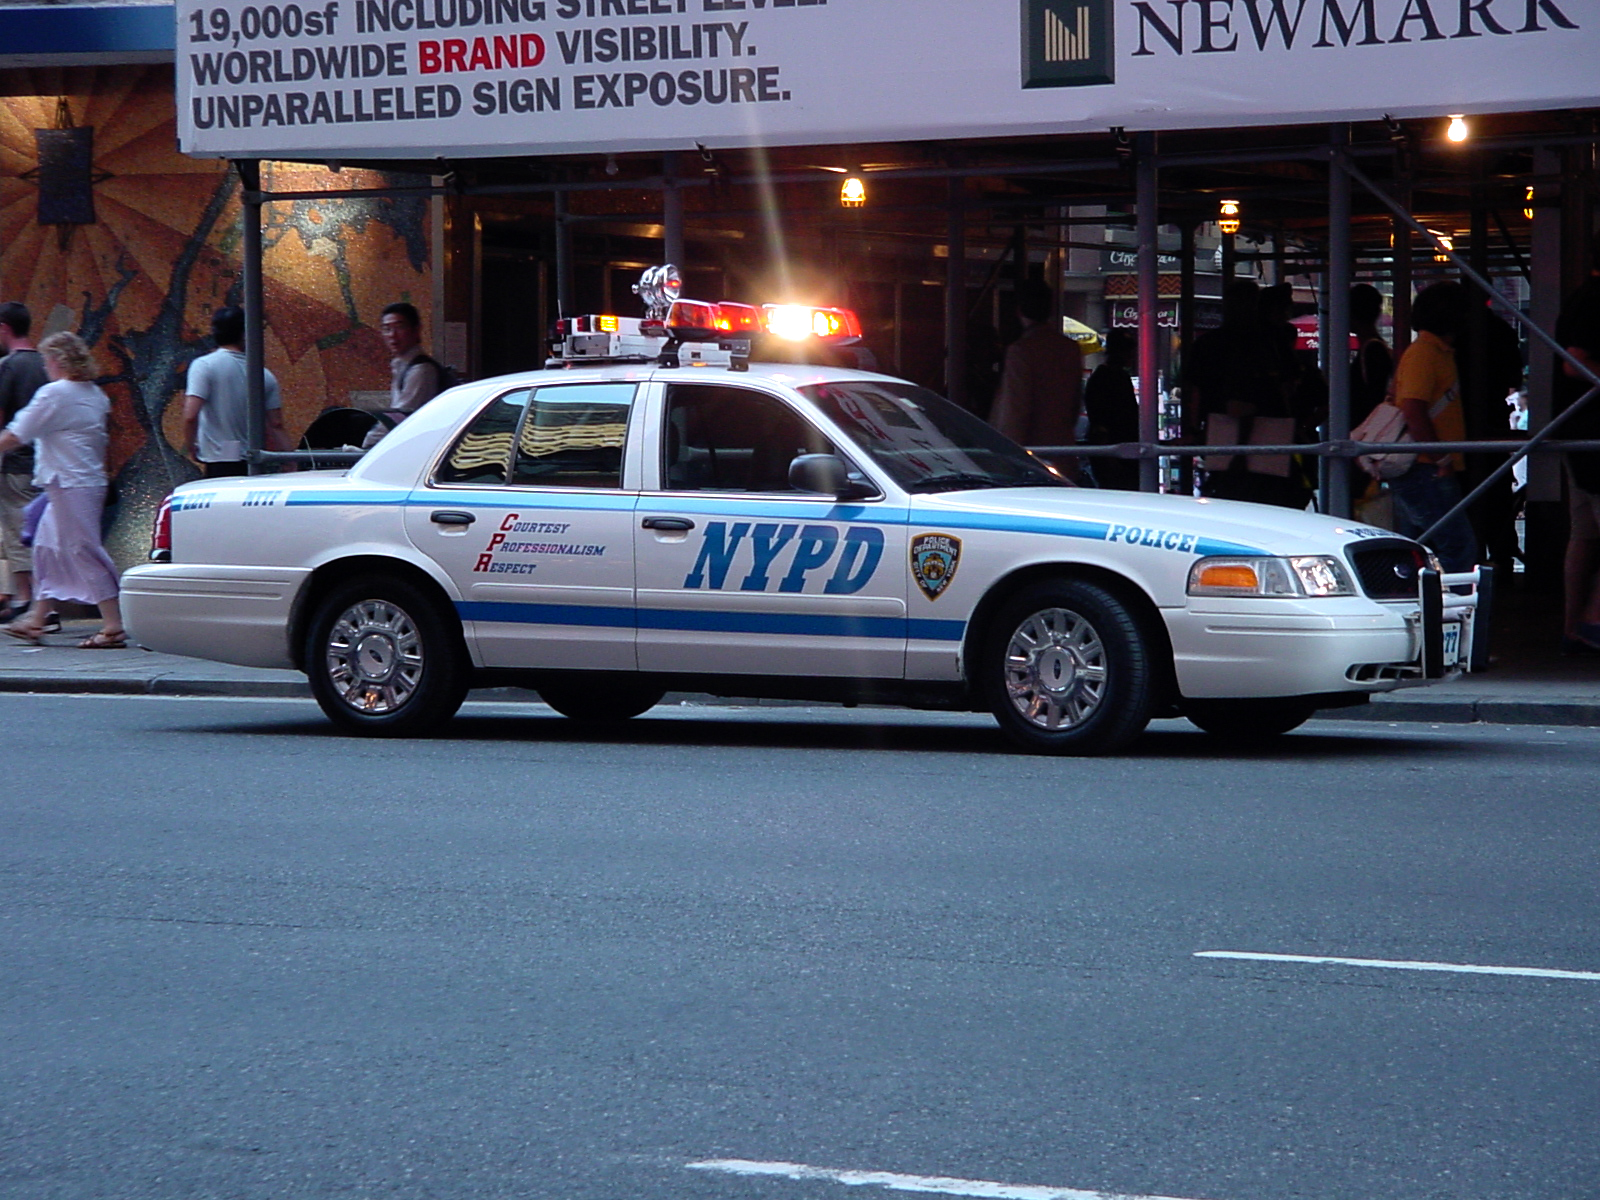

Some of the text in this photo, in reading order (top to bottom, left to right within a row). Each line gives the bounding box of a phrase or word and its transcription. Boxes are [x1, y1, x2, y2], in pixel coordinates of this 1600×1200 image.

[189, 2, 339, 49] 19,000sf
[355, 0, 546, 34] INCLUDING
[190, 21, 757, 86] WORLDWIDE BRAND VISIBILITY.
[1130, 0, 1581, 57] NEWMARK
[192, 67, 791, 130] UNPARALLELED SIGN EXPOSURE.
[683, 520, 886, 596] NYPD
[1108, 523, 1196, 554] POLICE
